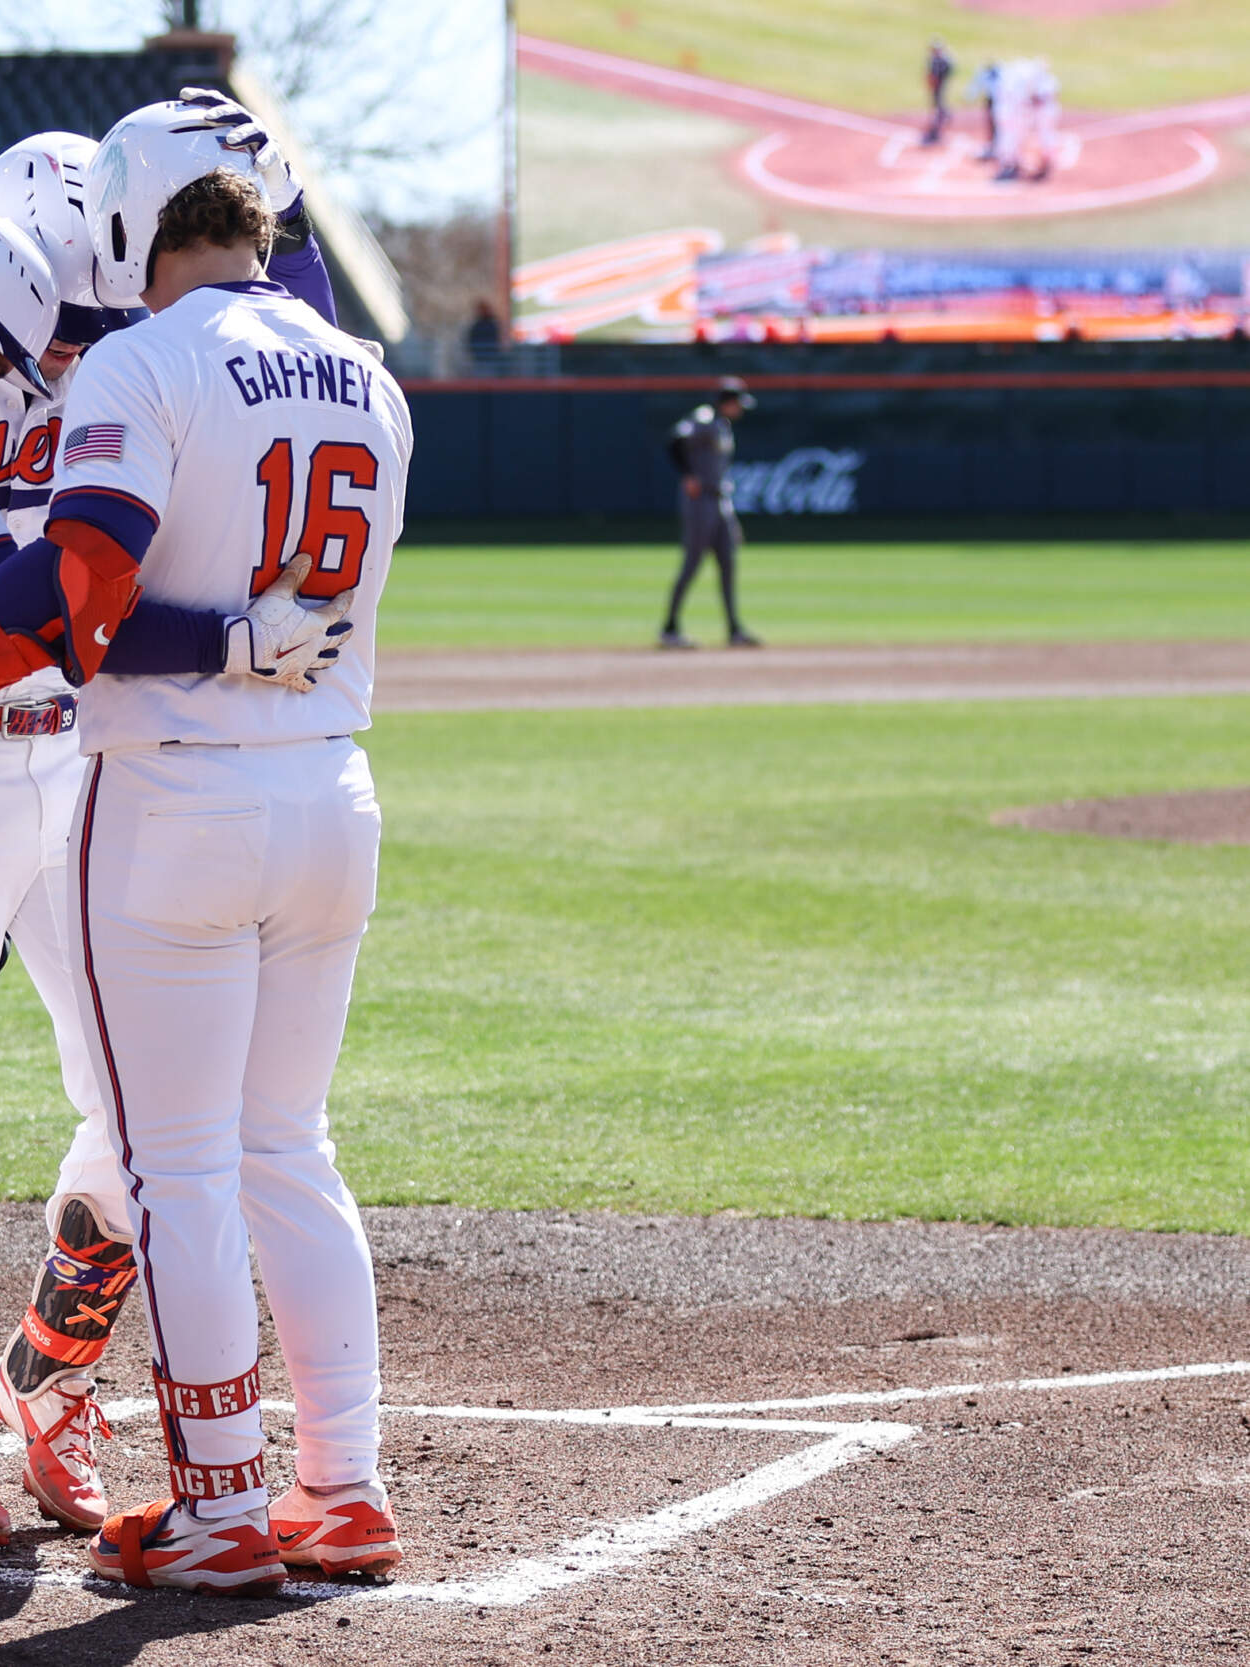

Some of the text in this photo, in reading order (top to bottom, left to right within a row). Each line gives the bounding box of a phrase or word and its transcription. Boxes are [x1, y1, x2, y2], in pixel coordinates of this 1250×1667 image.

[225, 350, 372, 413] GAFFNEY
[249, 438, 379, 600] 16
[61, 708, 73, 728] 99
